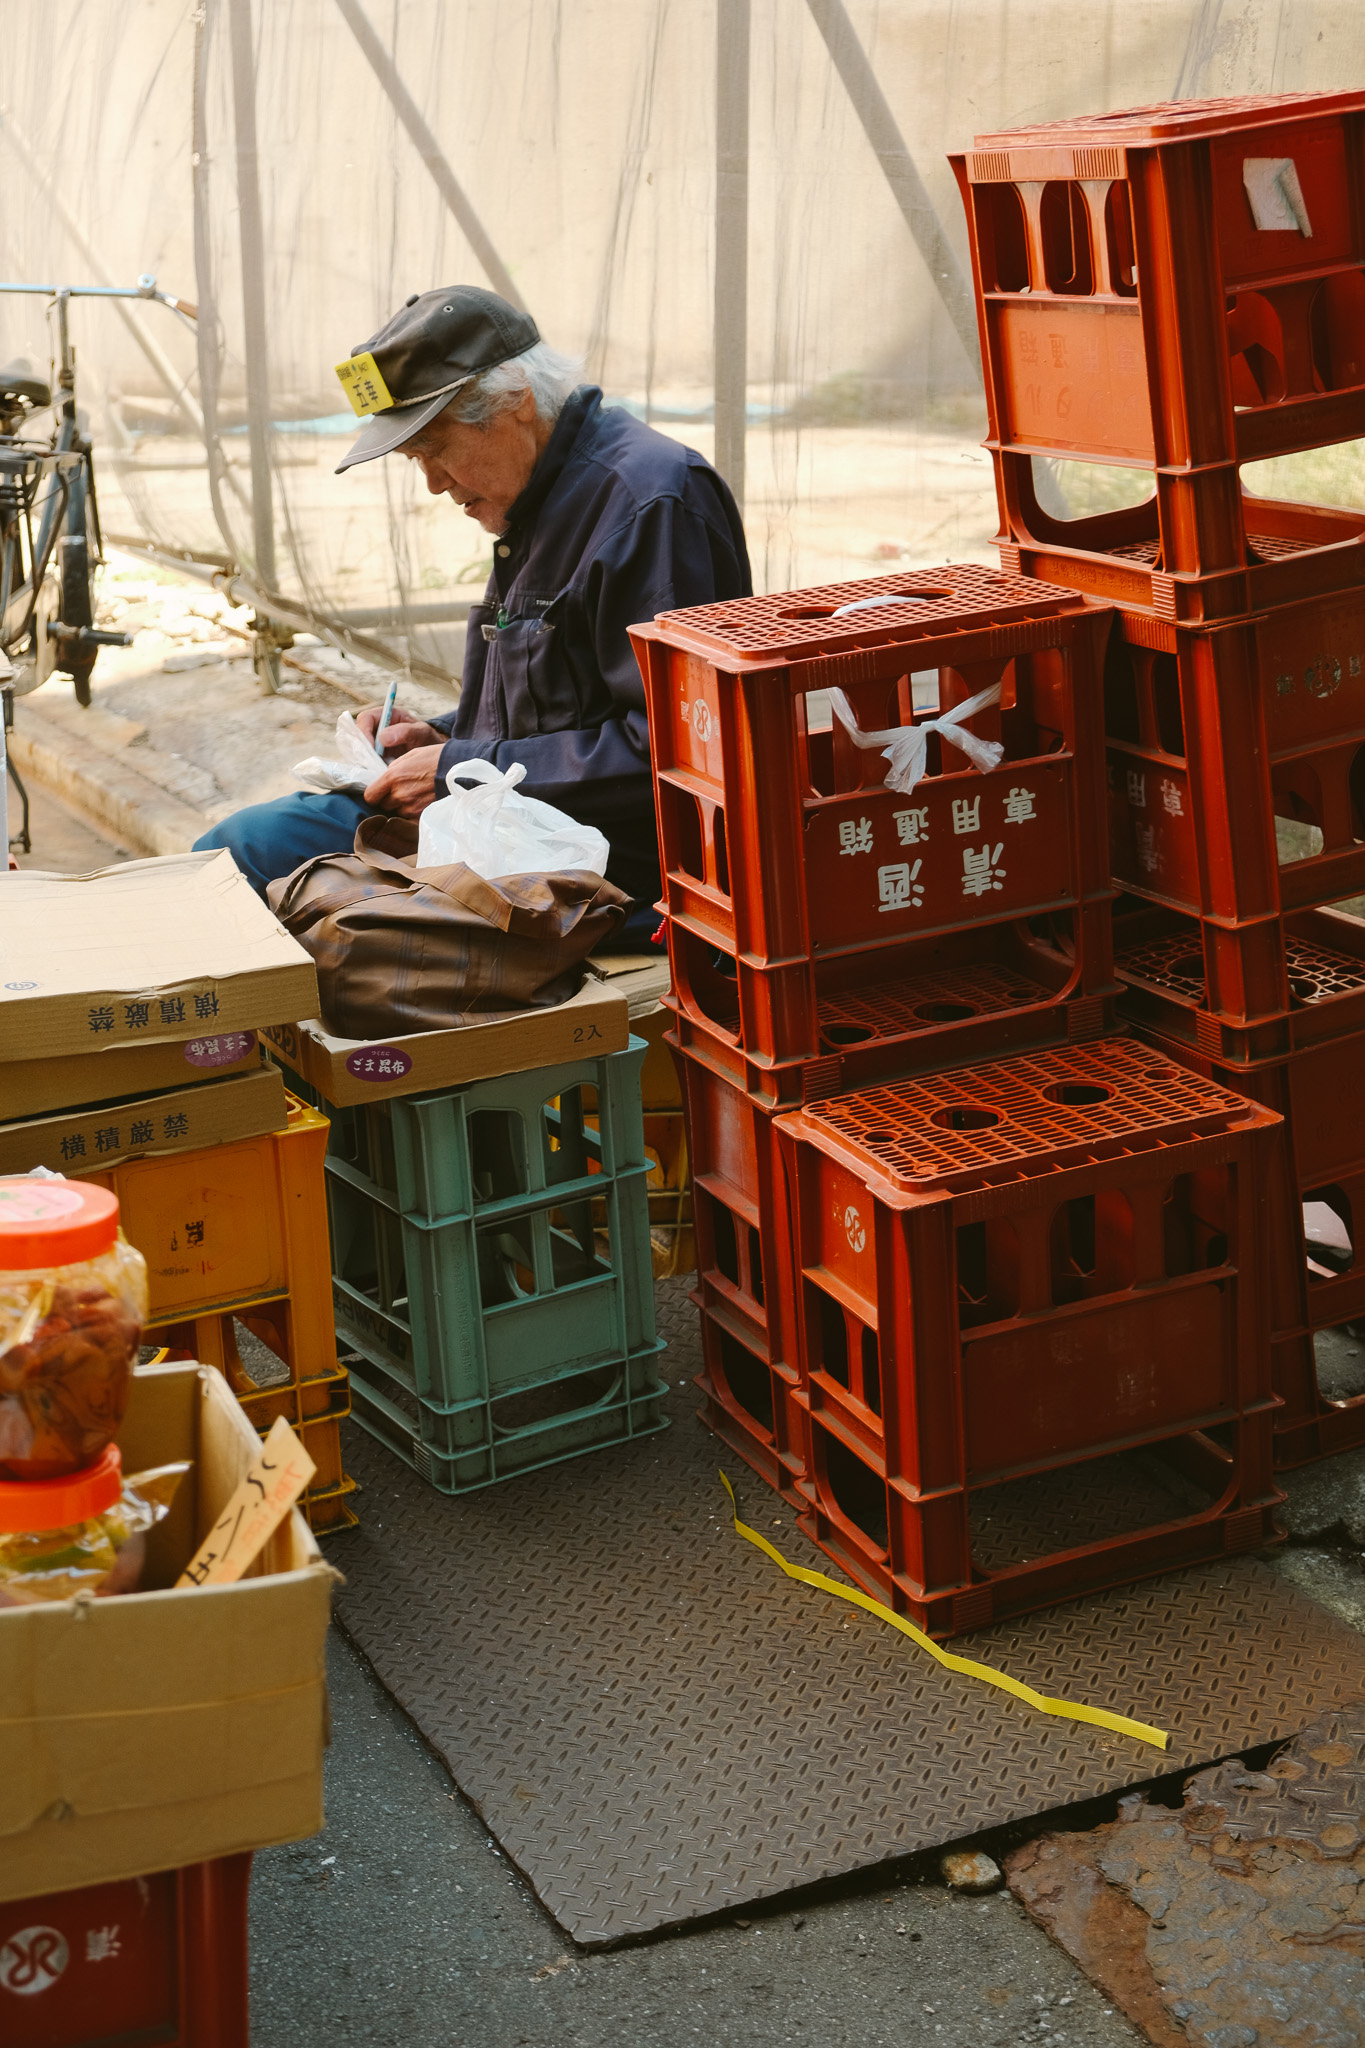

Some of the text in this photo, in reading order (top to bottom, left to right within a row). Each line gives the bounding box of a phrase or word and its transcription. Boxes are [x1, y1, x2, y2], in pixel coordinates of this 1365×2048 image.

[838, 787, 1037, 856] 専用通箱
[876, 841, 1008, 913] 清酒
[87, 991, 220, 1033] 横積厳禁
[573, 1024, 603, 1043] 2入
[353, 1058, 405, 1075] ごま昆布
[60, 1112, 190, 1161] 横積厳禁
